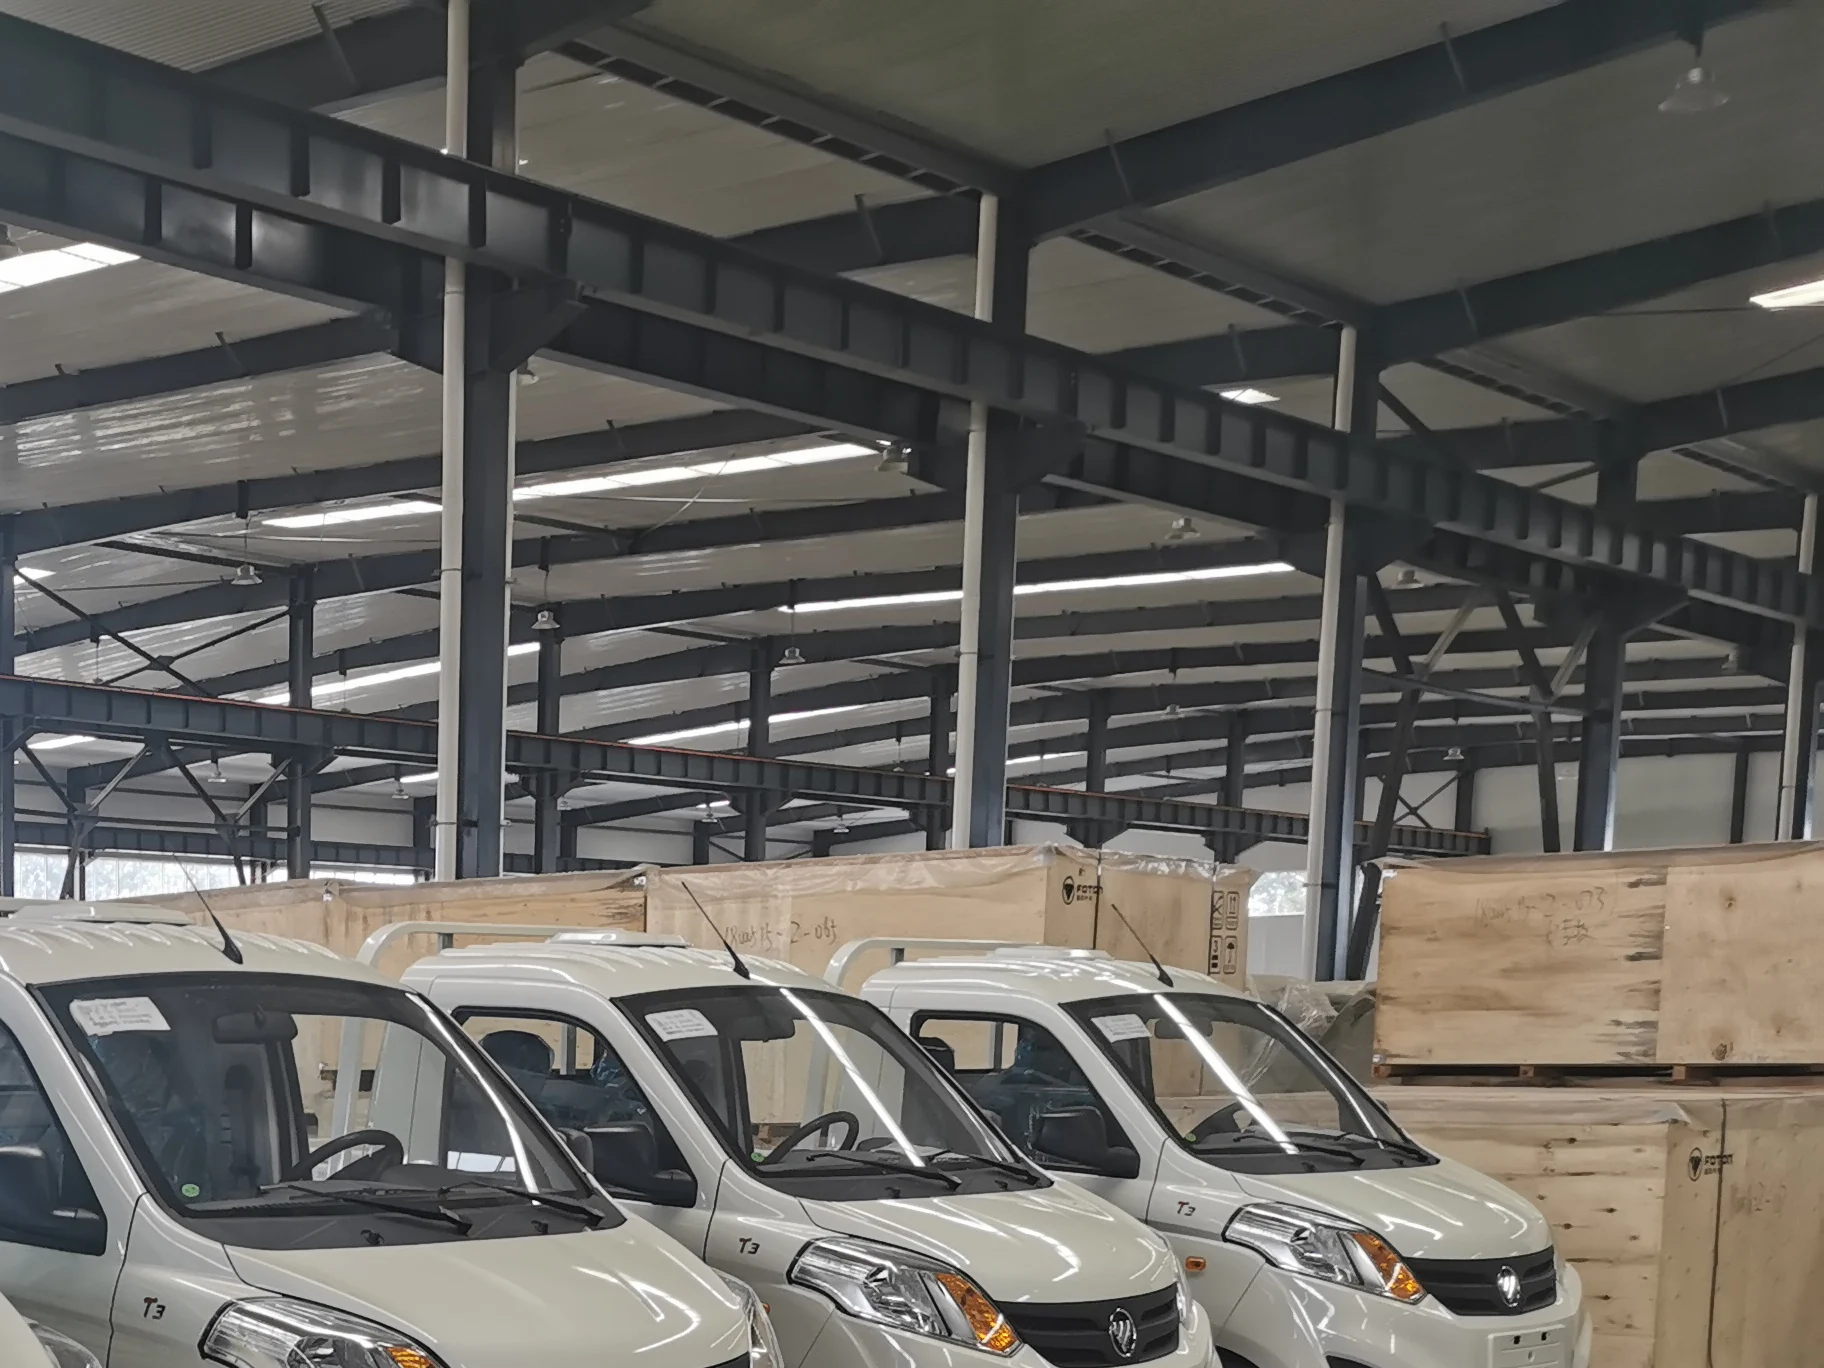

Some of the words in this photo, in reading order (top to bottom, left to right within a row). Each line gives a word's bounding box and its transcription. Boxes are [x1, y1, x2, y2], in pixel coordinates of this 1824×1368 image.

[1177, 1201, 1196, 1217] T3
[739, 1237, 761, 1255] T3
[143, 1296, 166, 1320] T3
